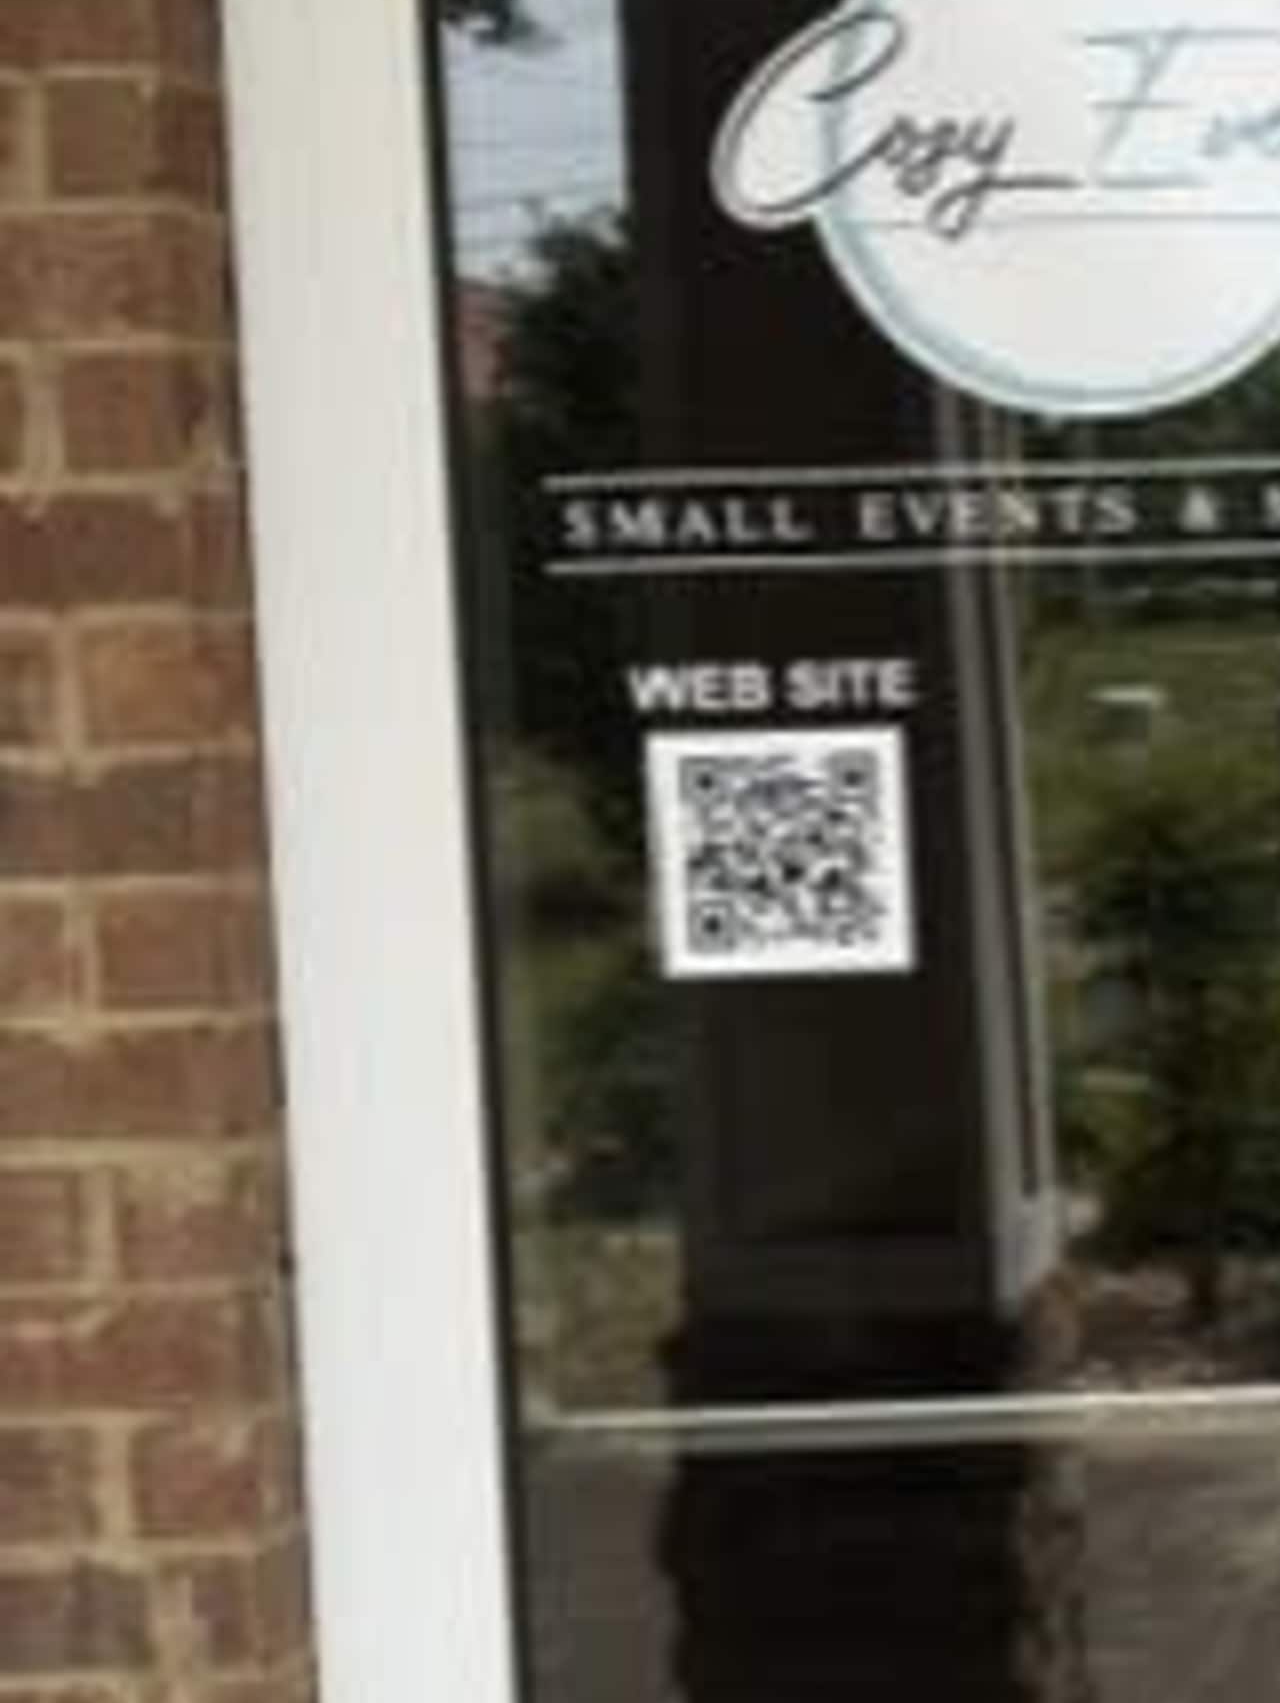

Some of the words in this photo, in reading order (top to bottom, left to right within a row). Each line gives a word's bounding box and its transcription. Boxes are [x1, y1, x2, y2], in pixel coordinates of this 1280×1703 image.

[711, 6, 1079, 240] Cozy
[562, 494, 817, 549] SMALL
[858, 487, 1138, 542] EVENTS
[1178, 485, 1218, 534] &
[627, 660, 770, 712] WEB
[785, 658, 917, 709] SITE
